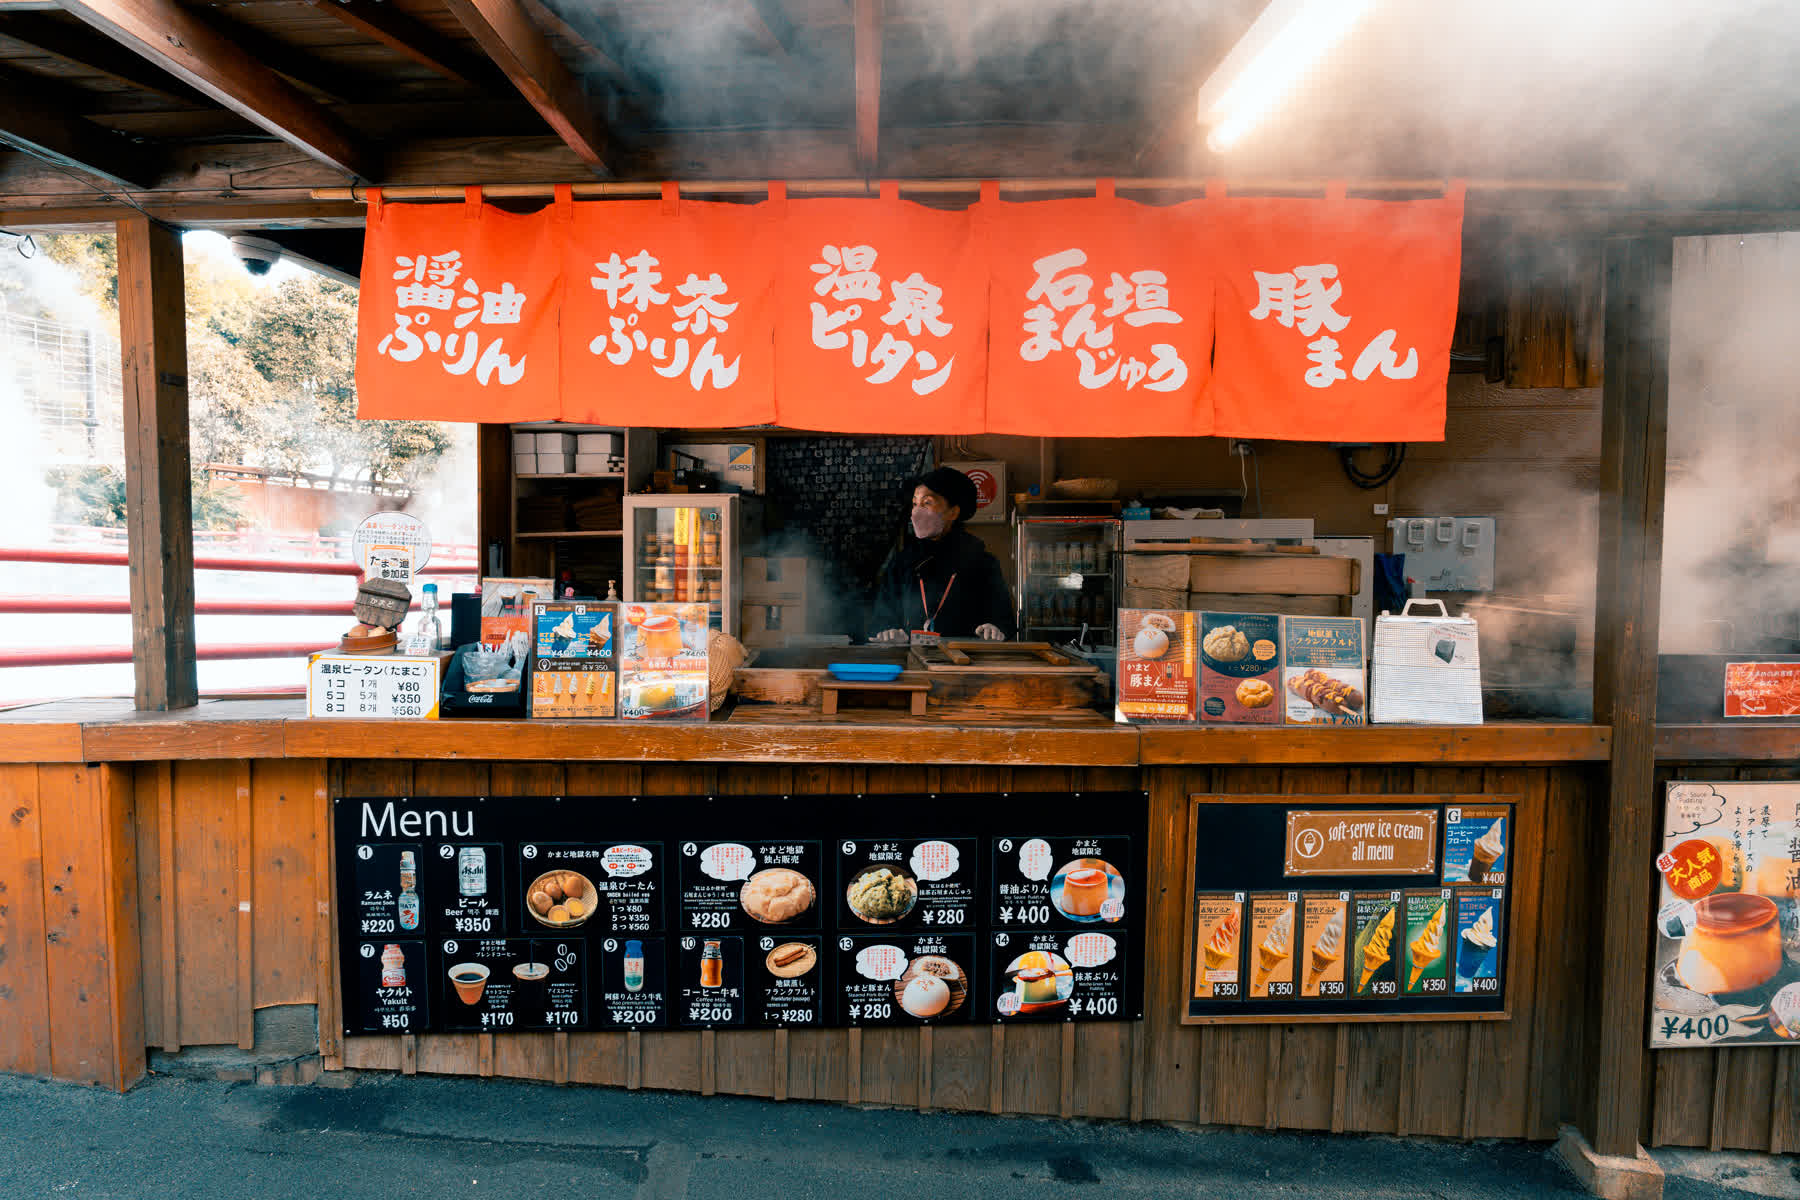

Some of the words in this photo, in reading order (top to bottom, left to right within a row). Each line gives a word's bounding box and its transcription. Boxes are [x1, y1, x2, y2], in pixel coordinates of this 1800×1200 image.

[393, 250, 527, 329] 醤油
[590, 249, 739, 335] 抹茶
[810, 245, 953, 337] 温泉
[1026, 248, 1183, 327] 石垣
[1249, 263, 1352, 336] 豚
[378, 313, 527, 386] ぷりん
[589, 313, 741, 391] ぷりん
[1020, 303, 1188, 392] まんじゅう
[1304, 329, 1418, 388] まん
[1297, 638, 1354, 646] フランクフルト
[1127, 663, 1151, 672] かまど
[398, 682, 420, 691] ¥80
[1130, 674, 1163, 688] 豚まん
[392, 694, 421, 703] ¥350
[392, 706, 421, 715] ¥560
[361, 802, 474, 836] Menu
[1447, 810, 1459, 822] G
[1328, 821, 1375, 841] soft-serve
[1378, 822, 1391, 839] ice
[1394, 823, 1424, 841] cream
[760, 846, 804, 854] かまど地獄
[874, 843, 899, 851] かまど
[1072, 847, 1102, 856] 地獄限定
[1352, 843, 1366, 861] all
[1367, 844, 1394, 861] menu
[548, 850, 599, 858] かまど地獄名物
[764, 855, 800, 864] 独占販売
[869, 852, 902, 860] 地獄限定
[1658, 855, 1673, 871] 超
[1670, 847, 1716, 886] 大人気
[462, 866, 483, 875] Asahi
[1482, 872, 1505, 884] ¥400
[1688, 869, 1713, 892] 商品
[364, 891, 393, 900] ラムネ
[1235, 893, 1243, 901] A
[1290, 893, 1297, 901] B
[1341, 892, 1349, 900] C
[1392, 892, 1400, 900] D
[1443, 890, 1450, 898] E
[459, 898, 488, 908] ビール
[692, 912, 730, 928] ¥280
[922, 909, 964, 924] ¥280
[1000, 906, 1049, 924] ¥400
[361, 920, 395, 932] ¥220
[455, 918, 491, 932] ¥350
[918, 937, 943, 945] かまど
[914, 945, 947, 954] 地獄限定
[845, 984, 891, 992] かまど豚まん
[1214, 983, 1238, 995] ¥350
[1269, 983, 1293, 995] ¥350
[1320, 982, 1344, 994] ¥350
[1372, 982, 1396, 994] ¥350
[1423, 979, 1446, 991] ¥350
[1473, 979, 1497, 991] ¥400
[375, 987, 413, 997] ヤクルト
[604, 993, 662, 1001] 阿蘇りんどう牛乳
[682, 988, 739, 997] コーヒー牛乳
[764, 988, 816, 996] フランクフルト
[849, 1004, 891, 1019] ¥280
[1069, 997, 1118, 1015] ¥400
[481, 1012, 514, 1025] ¥170
[546, 1011, 578, 1024] ¥170
[613, 1010, 656, 1023] ¥200
[689, 1008, 732, 1020] ¥200
[782, 1009, 813, 1022] ¥280
[382, 1014, 409, 1028] ¥50
[1661, 1014, 1729, 1040] ¥400
